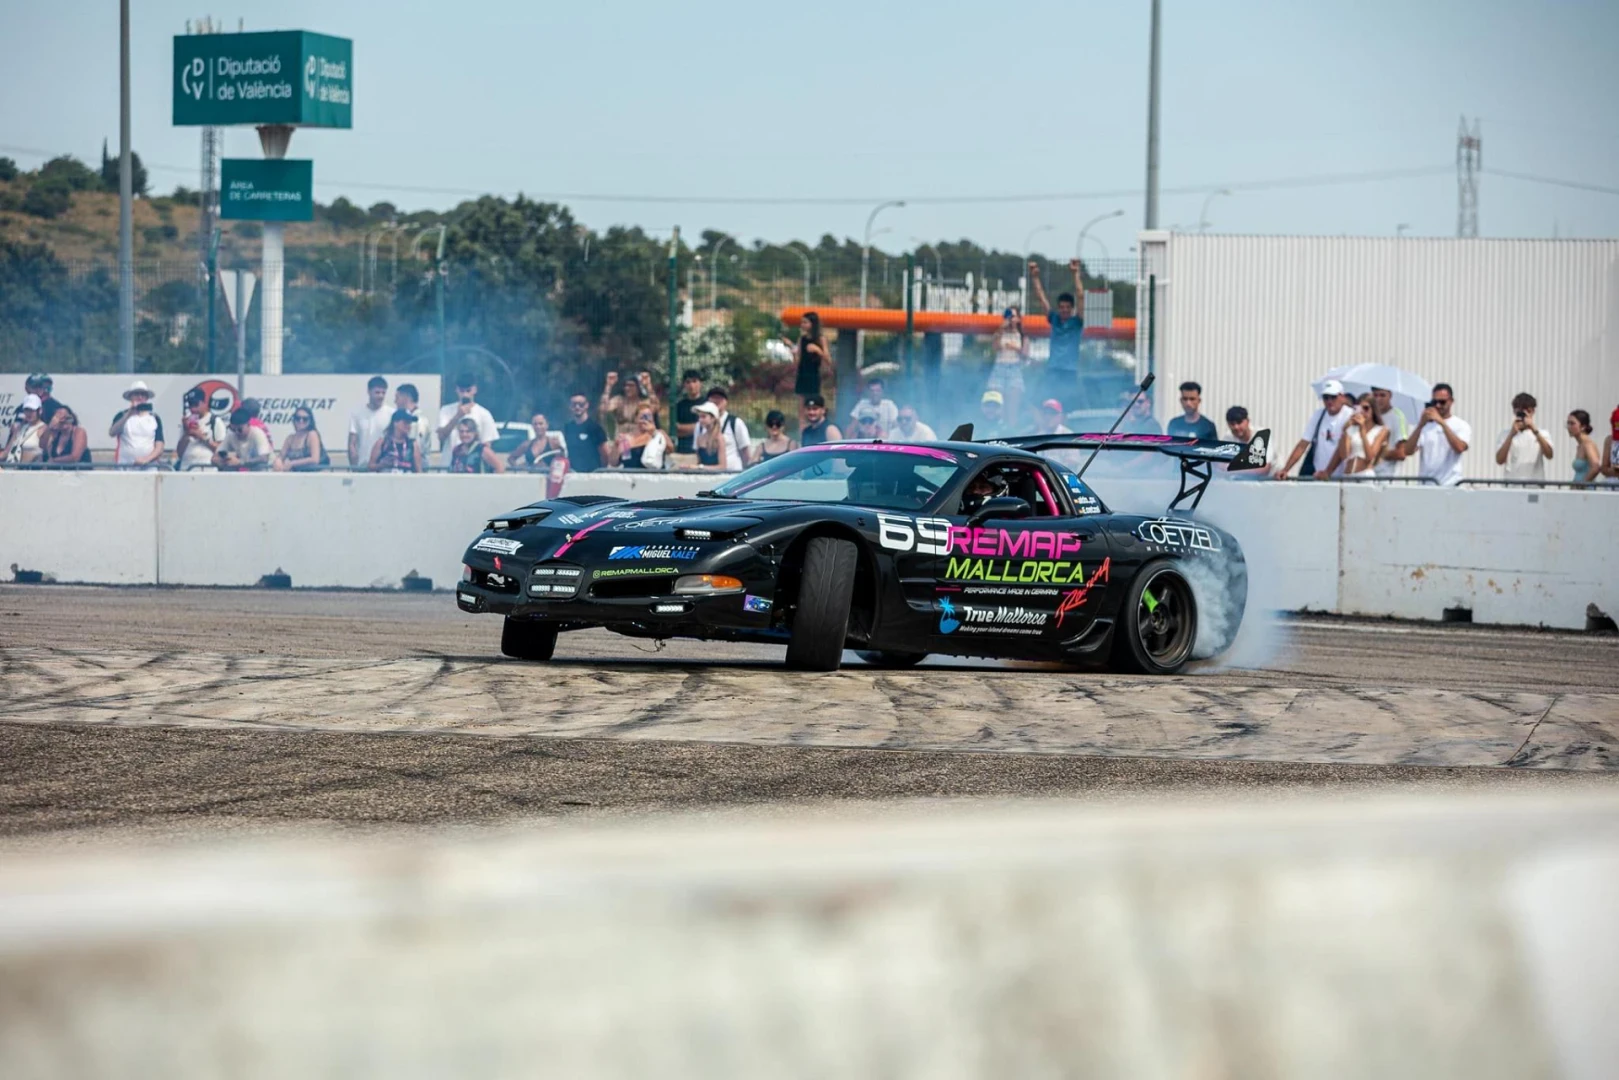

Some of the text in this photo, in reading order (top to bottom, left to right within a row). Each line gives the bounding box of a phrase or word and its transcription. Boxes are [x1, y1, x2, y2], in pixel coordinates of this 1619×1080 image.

[217, 55, 281, 78] Diputació
[217, 80, 292, 100] de València
[229, 191, 241, 201] DE
[877, 512, 954, 556] 69
[946, 526, 1082, 559] REMAP
[945, 557, 1084, 583] MALLORCA
[963, 587, 1006, 595] PERFORMANCE
[1007, 588, 1024, 596] MADE
[1031, 589, 1059, 597] GERMANY
[958, 625, 976, 634] Making
[976, 627, 987, 635] your
[988, 626, 1002, 634] island
[1002, 627, 1020, 635] dreams
